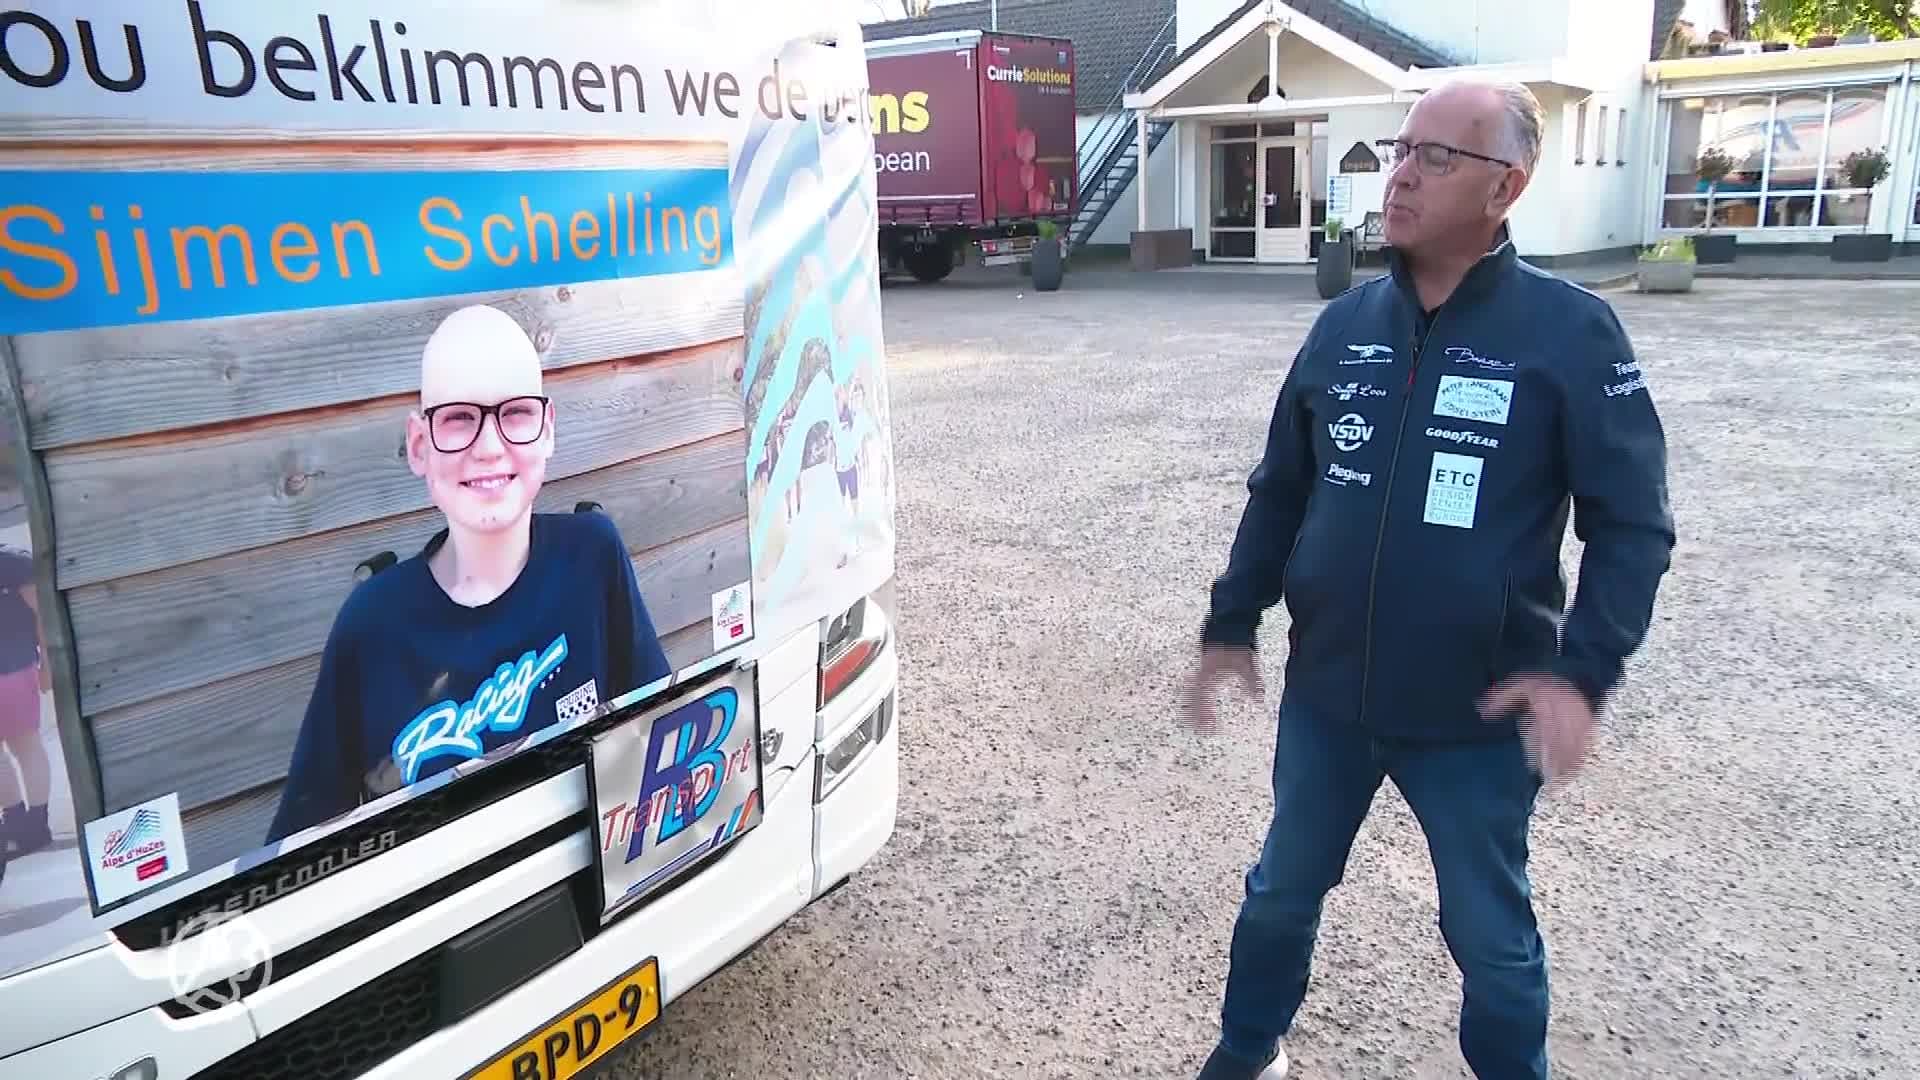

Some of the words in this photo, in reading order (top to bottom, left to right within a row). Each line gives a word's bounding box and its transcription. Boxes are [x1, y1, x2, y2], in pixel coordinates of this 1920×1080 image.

[0, 10, 147, 93] ou
[187, 0, 646, 113] beklimmen
[665, 67, 740, 118] we
[758, 57, 808, 121] de
[0, 203, 381, 316] Sijmen
[418, 192, 723, 272] Schelling
[1327, 423, 1375, 442] VSDV
[1425, 427, 1500, 449] GOODYEAR
[1434, 469, 1476, 487] ETC
[1432, 489, 1474, 501] DESIGN
[396, 637, 568, 783] Racing
[558, 683, 595, 711] TOURING
[603, 738, 752, 852] Transport
[102, 854, 125, 870] Alpe
[511, 983, 642, 1080] BPD-9
